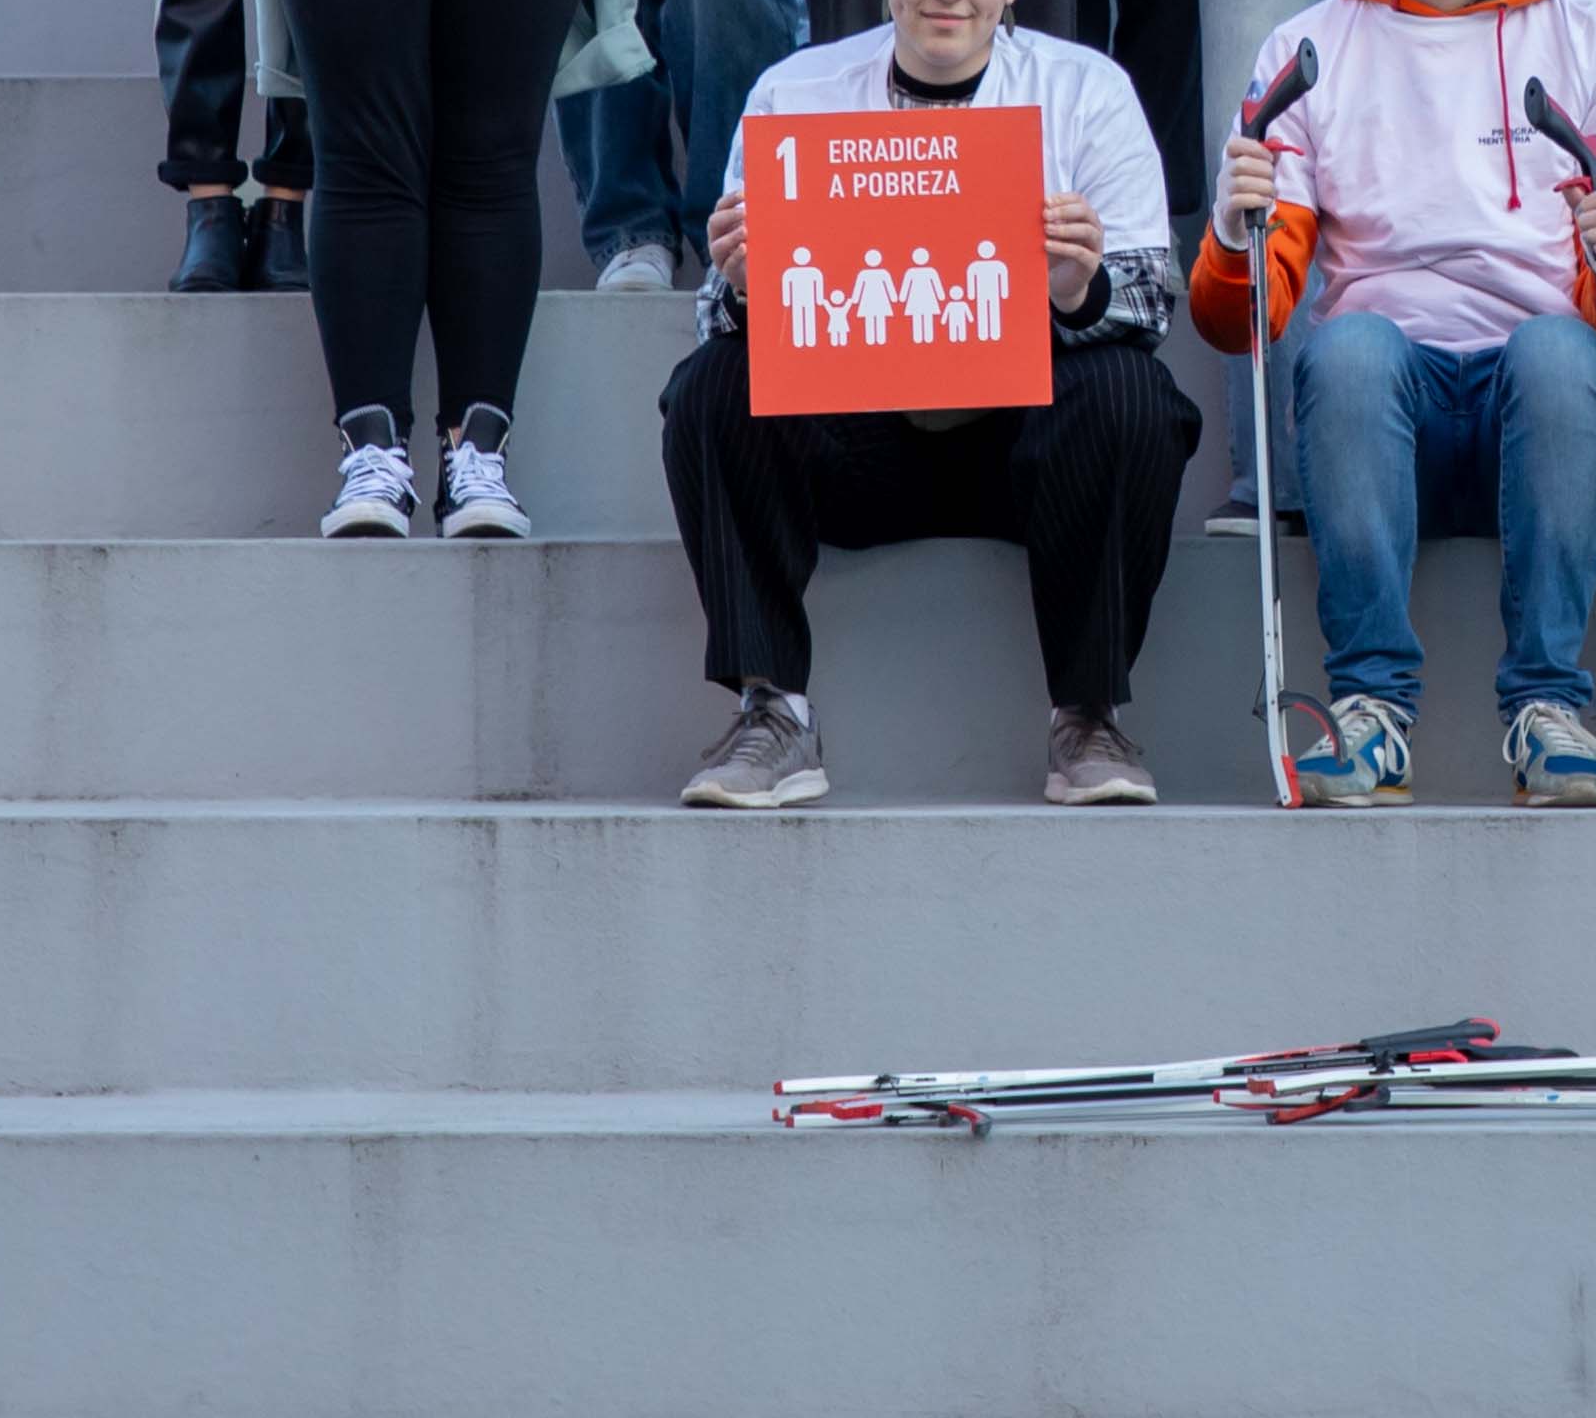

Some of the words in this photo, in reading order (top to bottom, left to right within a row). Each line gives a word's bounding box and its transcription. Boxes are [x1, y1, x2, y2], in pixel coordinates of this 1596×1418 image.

[829, 135, 958, 164] ERRADICAR
[776, 136, 798, 200] 1
[829, 174, 845, 198] A
[853, 170, 960, 198] POBREZA
